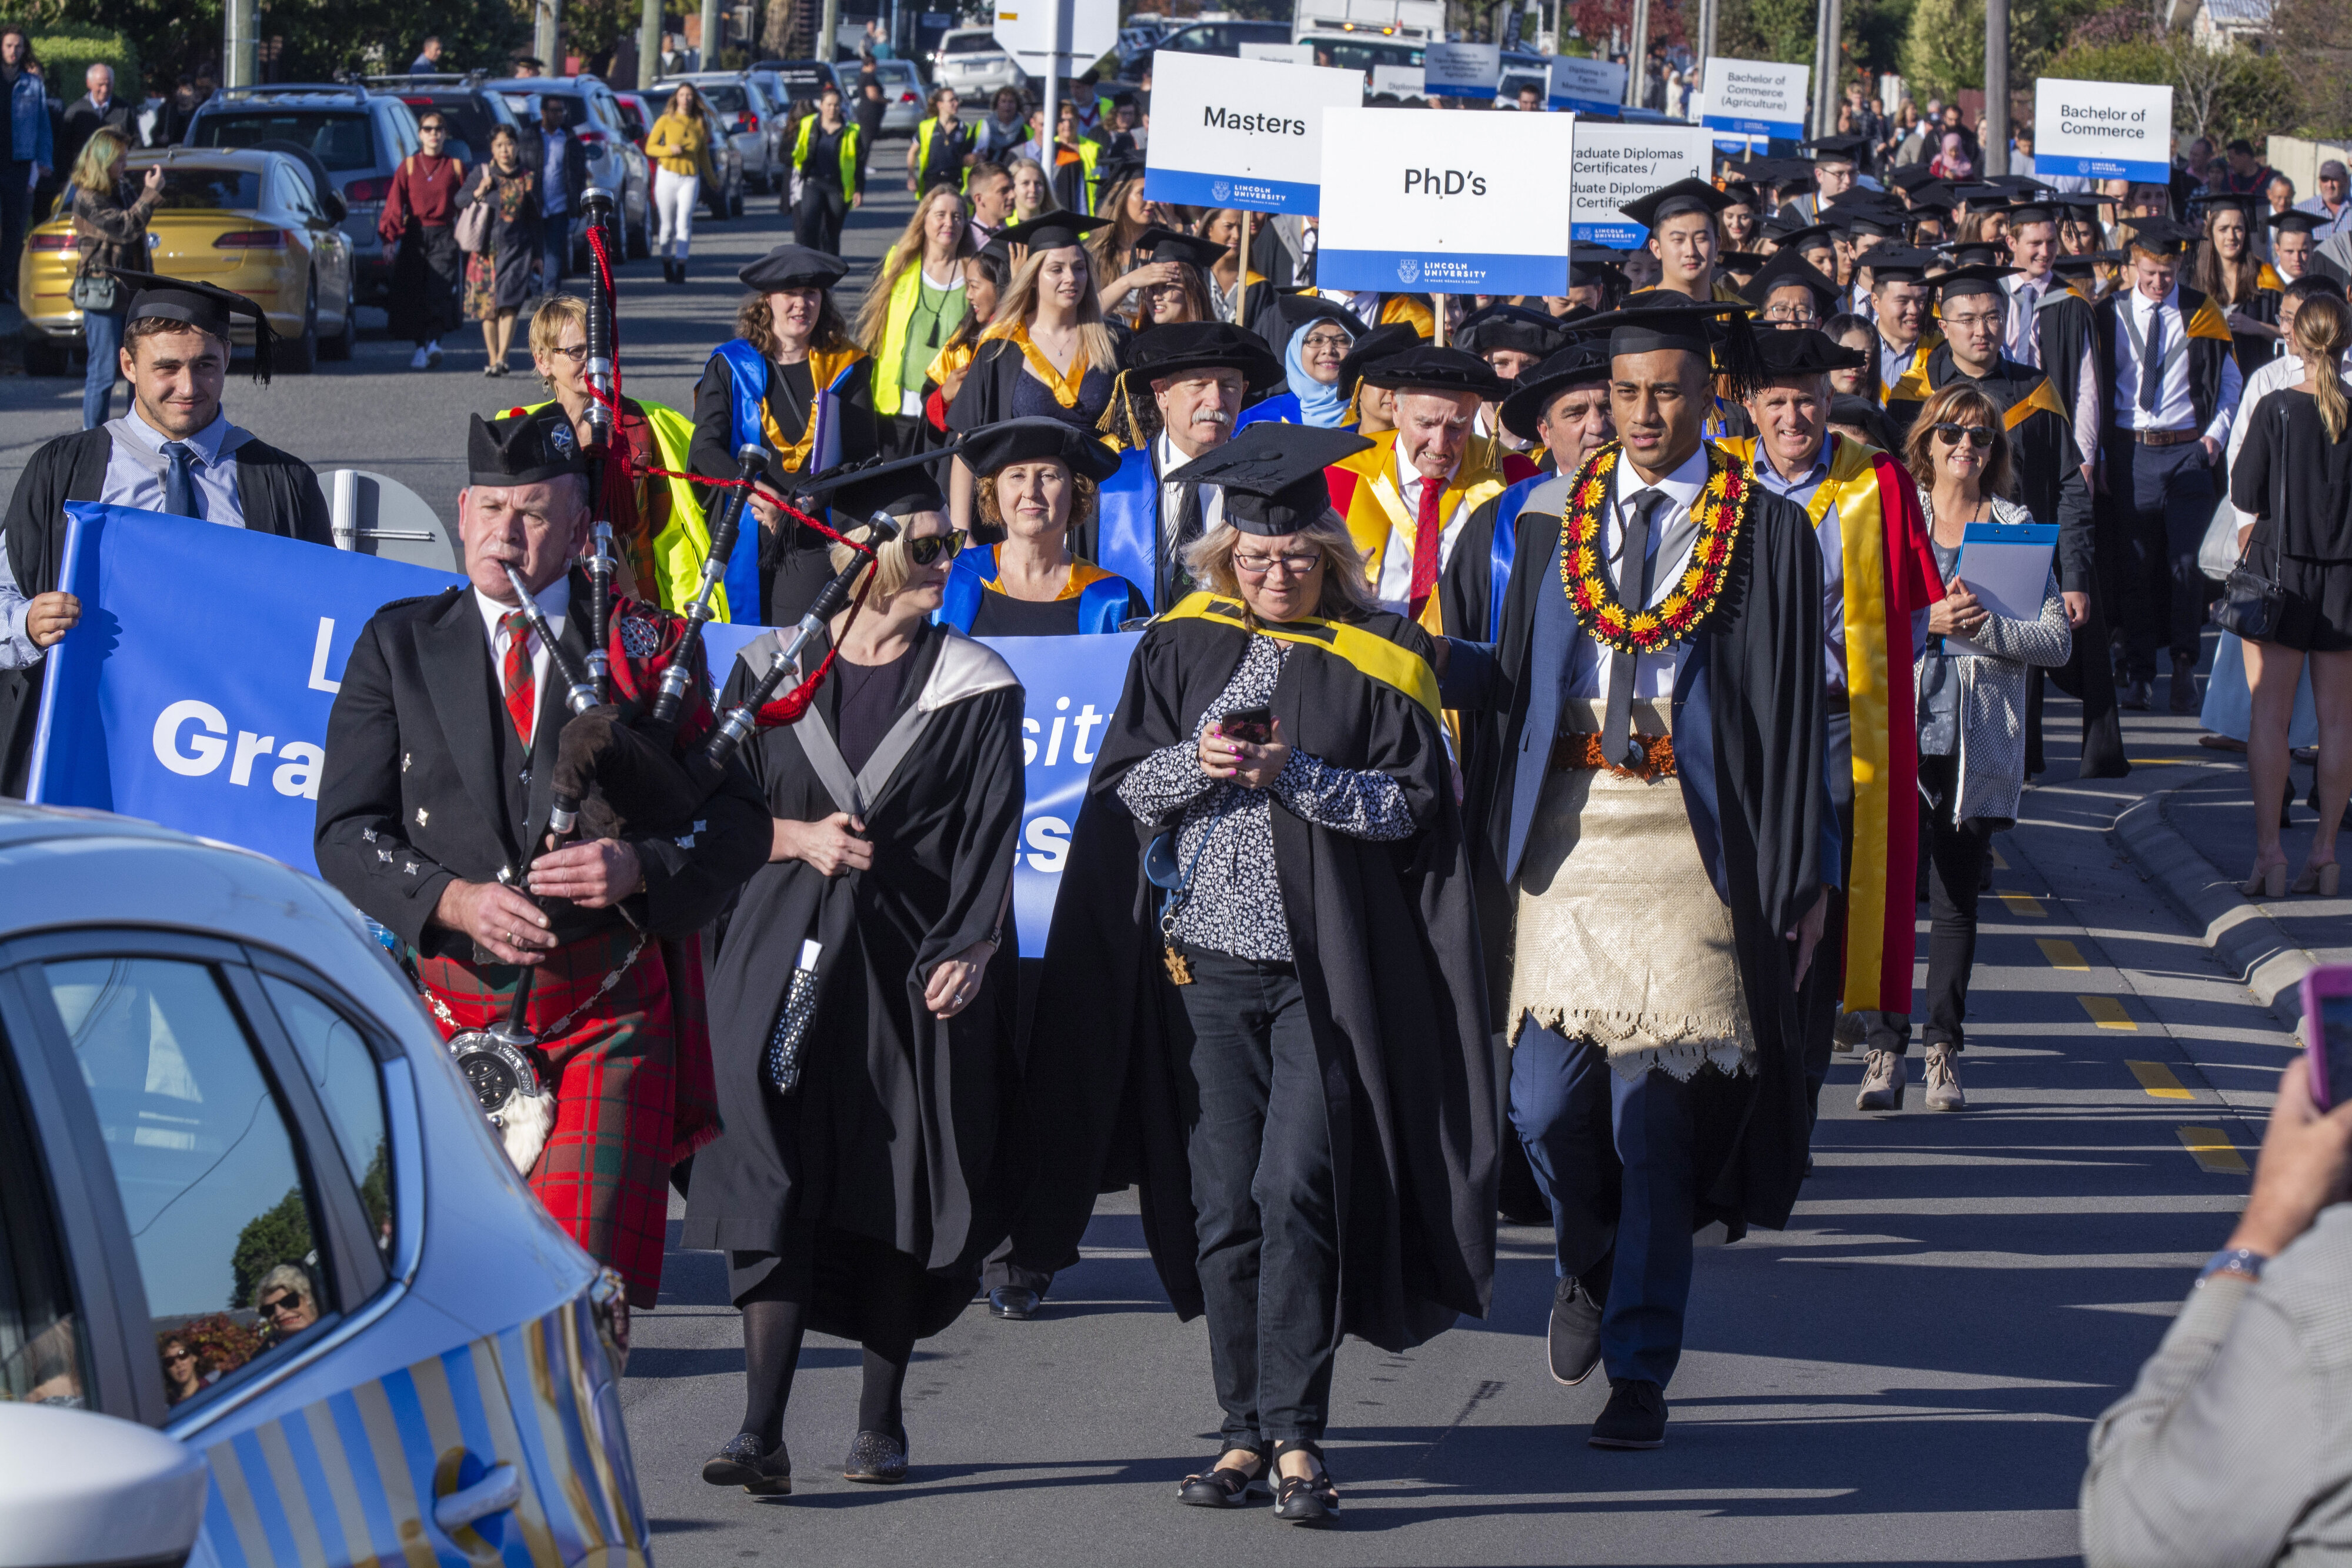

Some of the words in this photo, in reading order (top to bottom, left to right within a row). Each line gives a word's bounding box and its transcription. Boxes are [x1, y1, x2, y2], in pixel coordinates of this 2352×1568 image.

[1727, 72, 1773, 85] Bachelor
[1774, 75, 1786, 85] of
[1727, 84, 1784, 98] Commerce
[1721, 95, 1787, 112] (Agriculture)
[2061, 105, 2127, 121] Bachelor
[2131, 109, 2146, 122] of
[1204, 106, 1305, 136] Masters
[2061, 121, 2144, 139] Commerce
[1624, 147, 1684, 161] Diplomas
[1573, 162, 1647, 173] Certificates
[1234, 184, 1271, 194] LINCOLN
[1234, 191, 1286, 201] UNIVERSITY
[1577, 196, 1636, 208] Certifica
[1424, 262, 1467, 270] LINCOLN
[1424, 269, 1486, 278] UNIVERSITY
